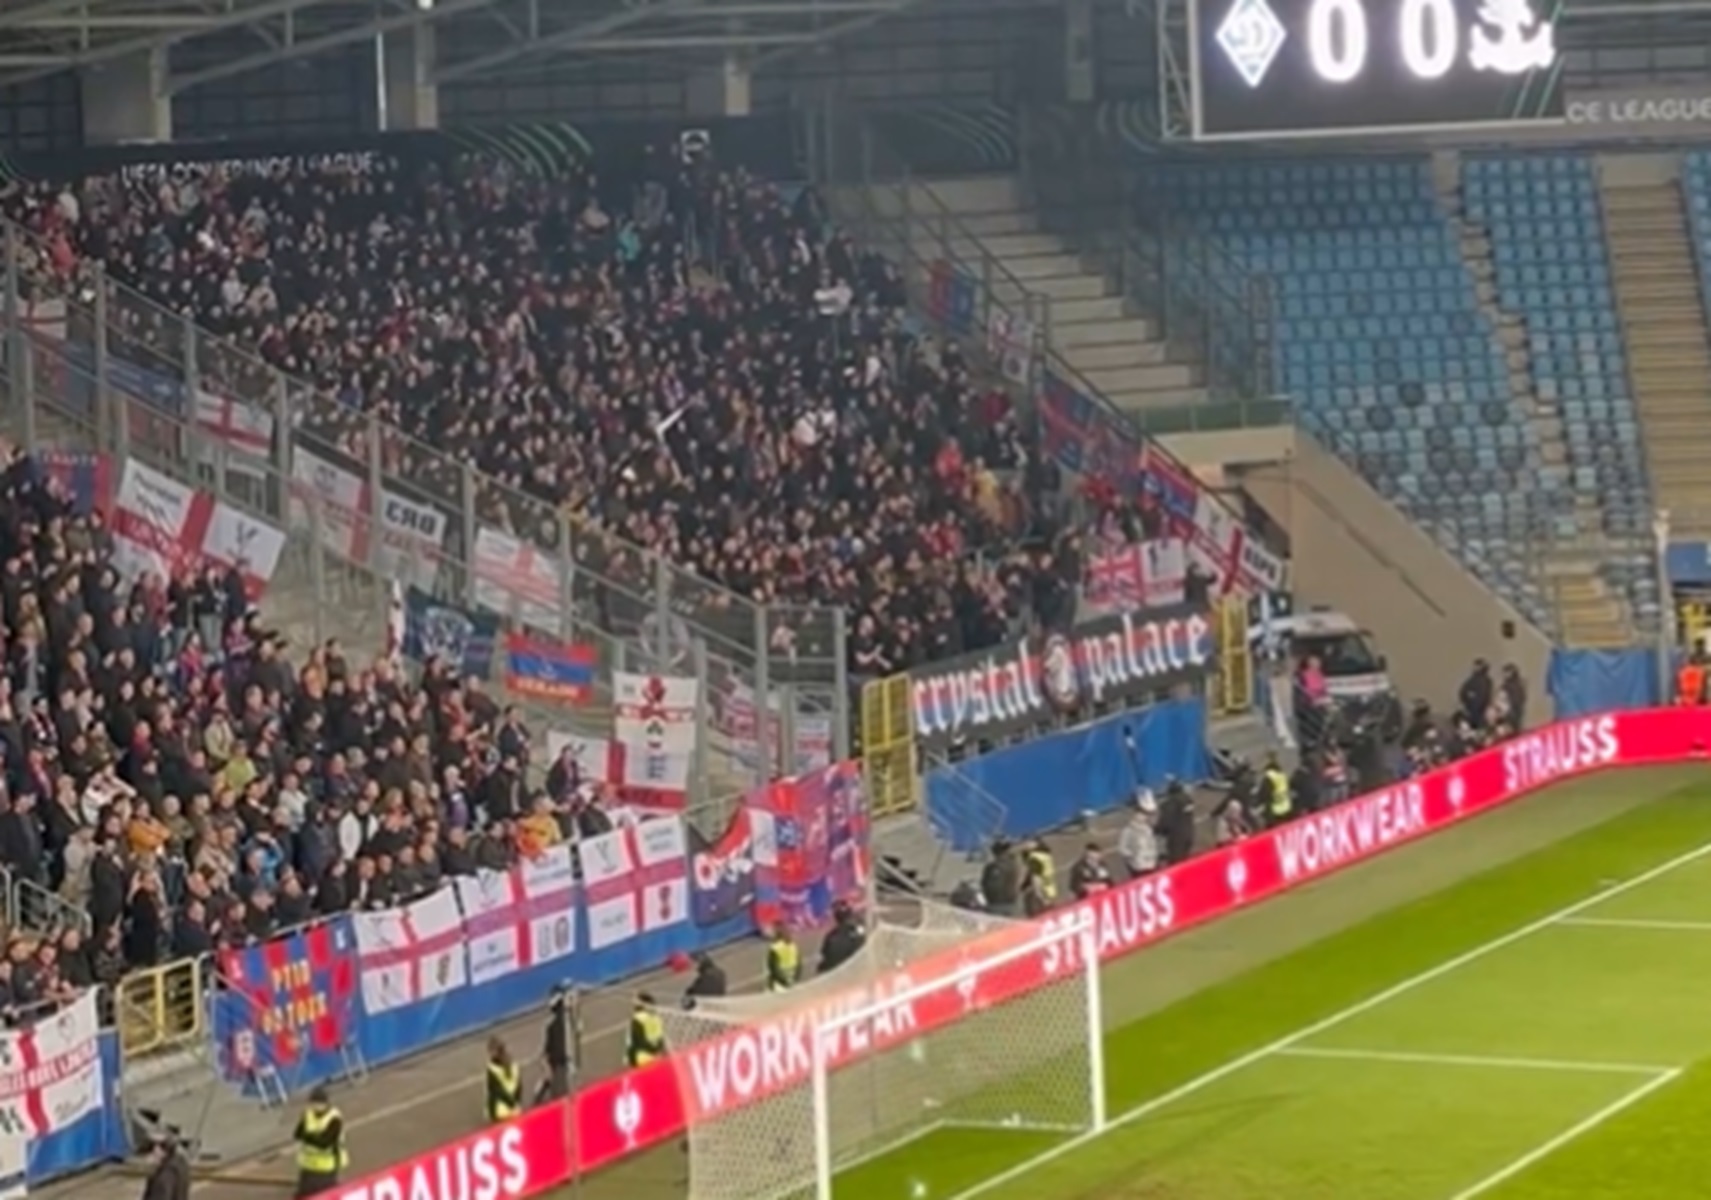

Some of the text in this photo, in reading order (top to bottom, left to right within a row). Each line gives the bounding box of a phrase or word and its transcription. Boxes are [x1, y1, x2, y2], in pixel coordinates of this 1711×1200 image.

[1609, 98, 1711, 121] LEAGUE
[1082, 612, 1208, 702] palace
[1504, 716, 1618, 791] STRAUSS
[1273, 783, 1425, 881] WORKWEAR
[1042, 876, 1174, 974] STRAUSS
[688, 973, 917, 1112] WORKWEAR
